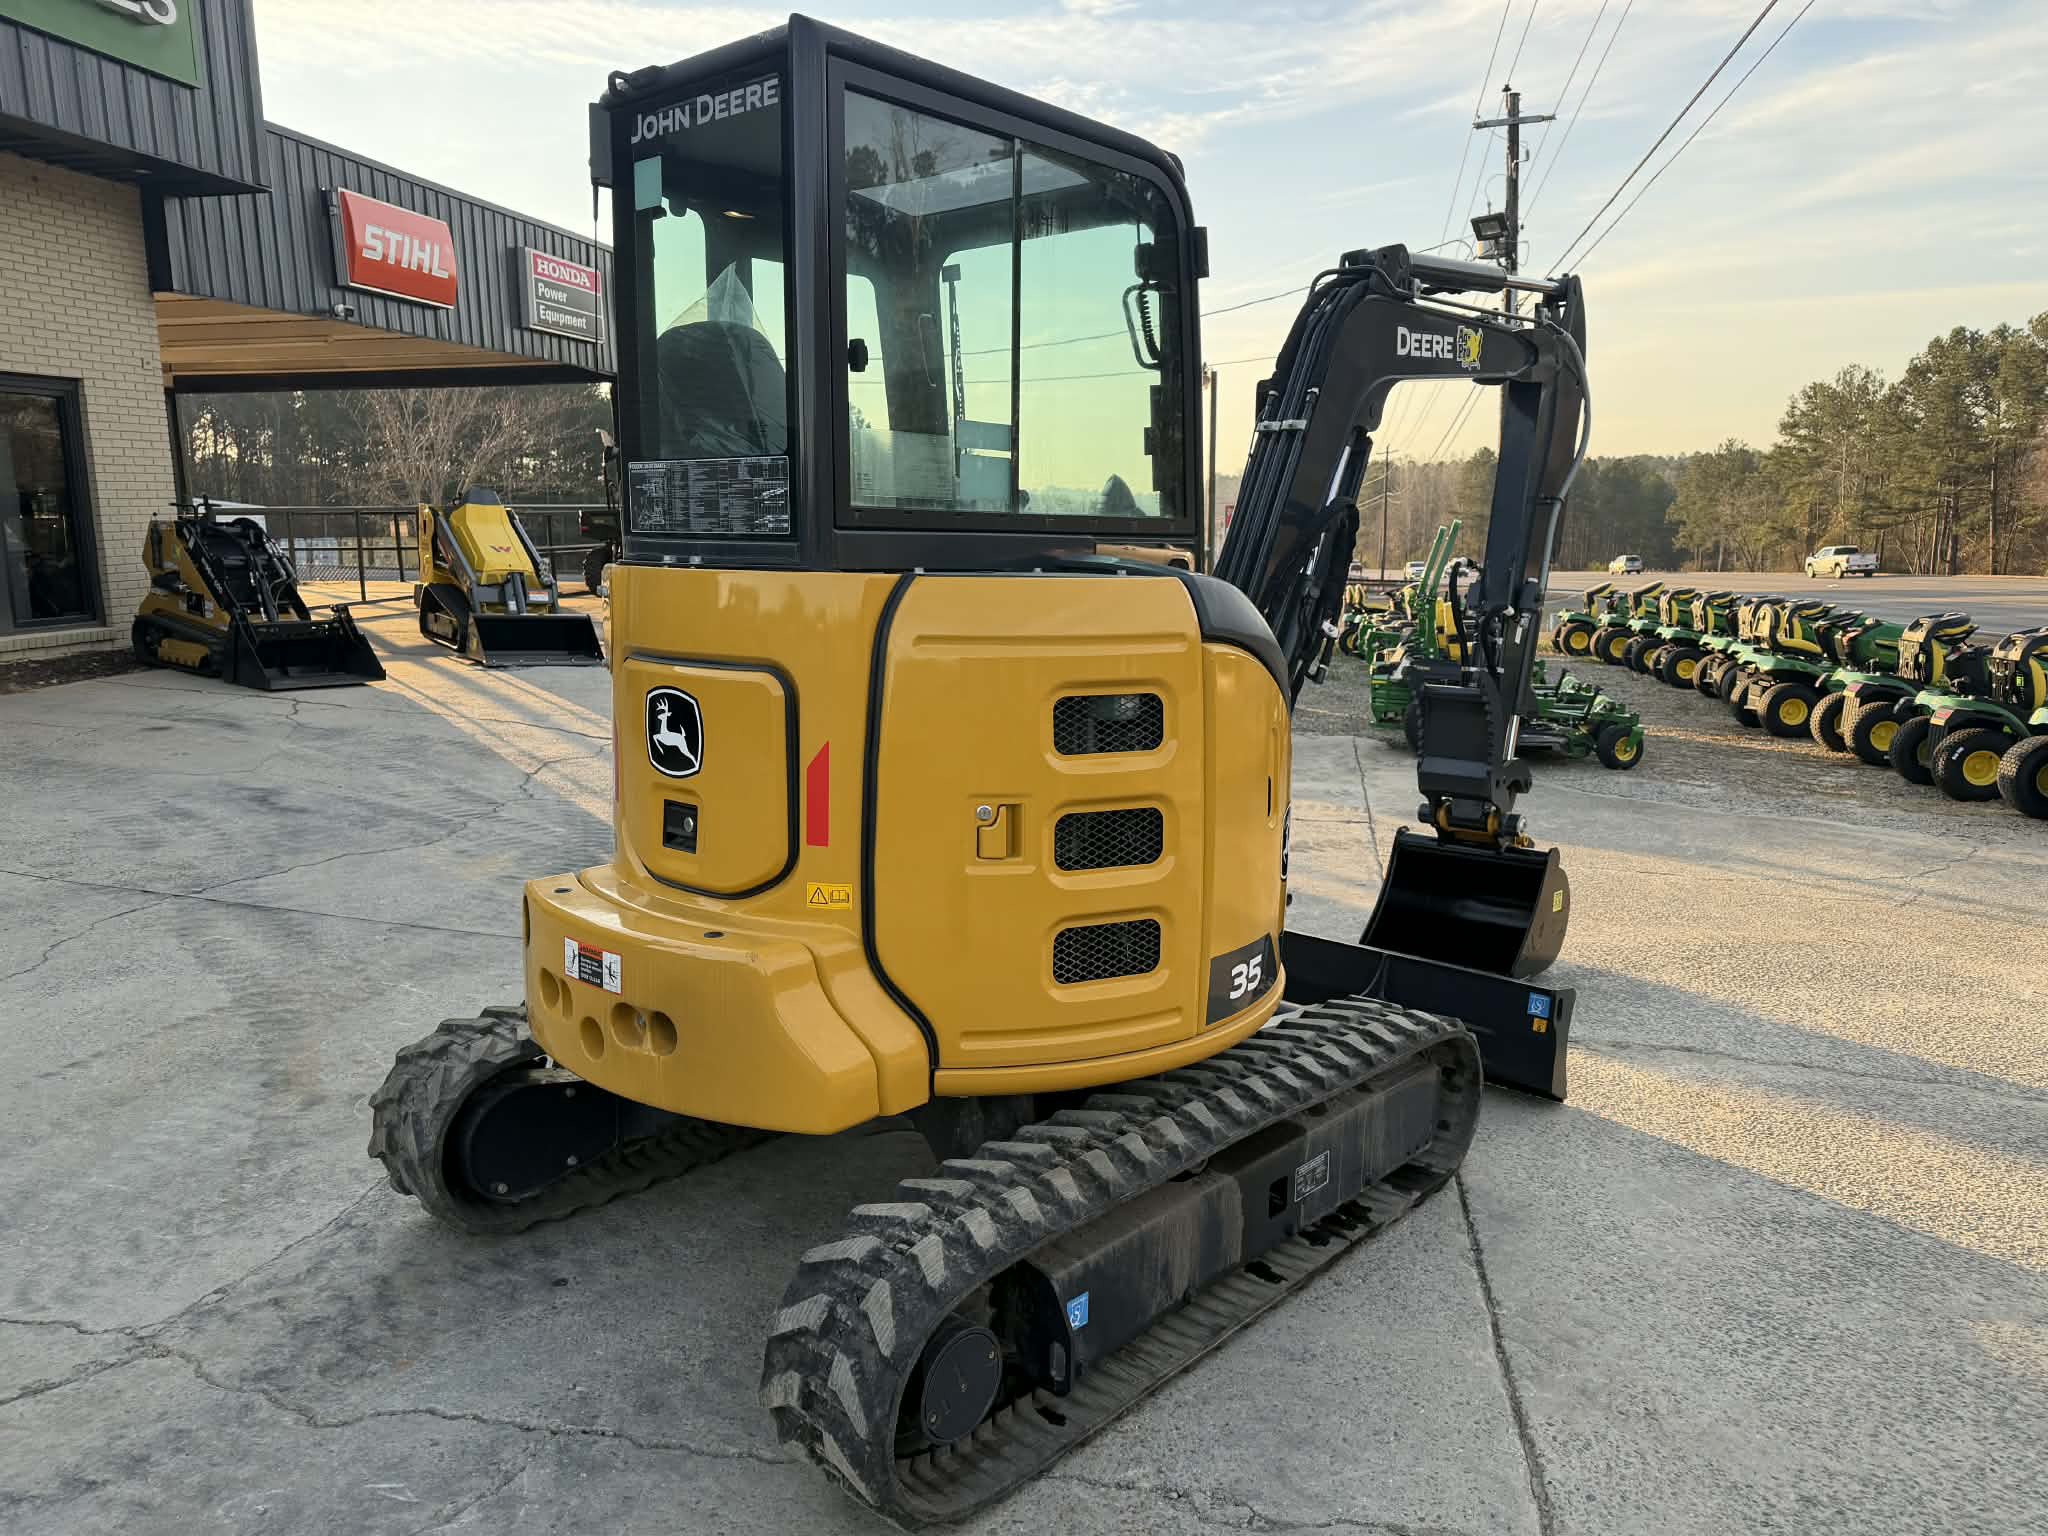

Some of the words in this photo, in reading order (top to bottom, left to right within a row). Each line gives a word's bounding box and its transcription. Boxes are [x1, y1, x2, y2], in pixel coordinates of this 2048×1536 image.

[630, 104, 690, 144] JOHN
[696, 77, 779, 126] DEERE
[362, 223, 449, 279] STIHL
[536, 257, 592, 289] HONDA
[537, 282, 568, 304] Power
[539, 304, 588, 329] Equipment
[1397, 326, 1455, 359] DEERE
[1229, 953, 1263, 1000] 35
